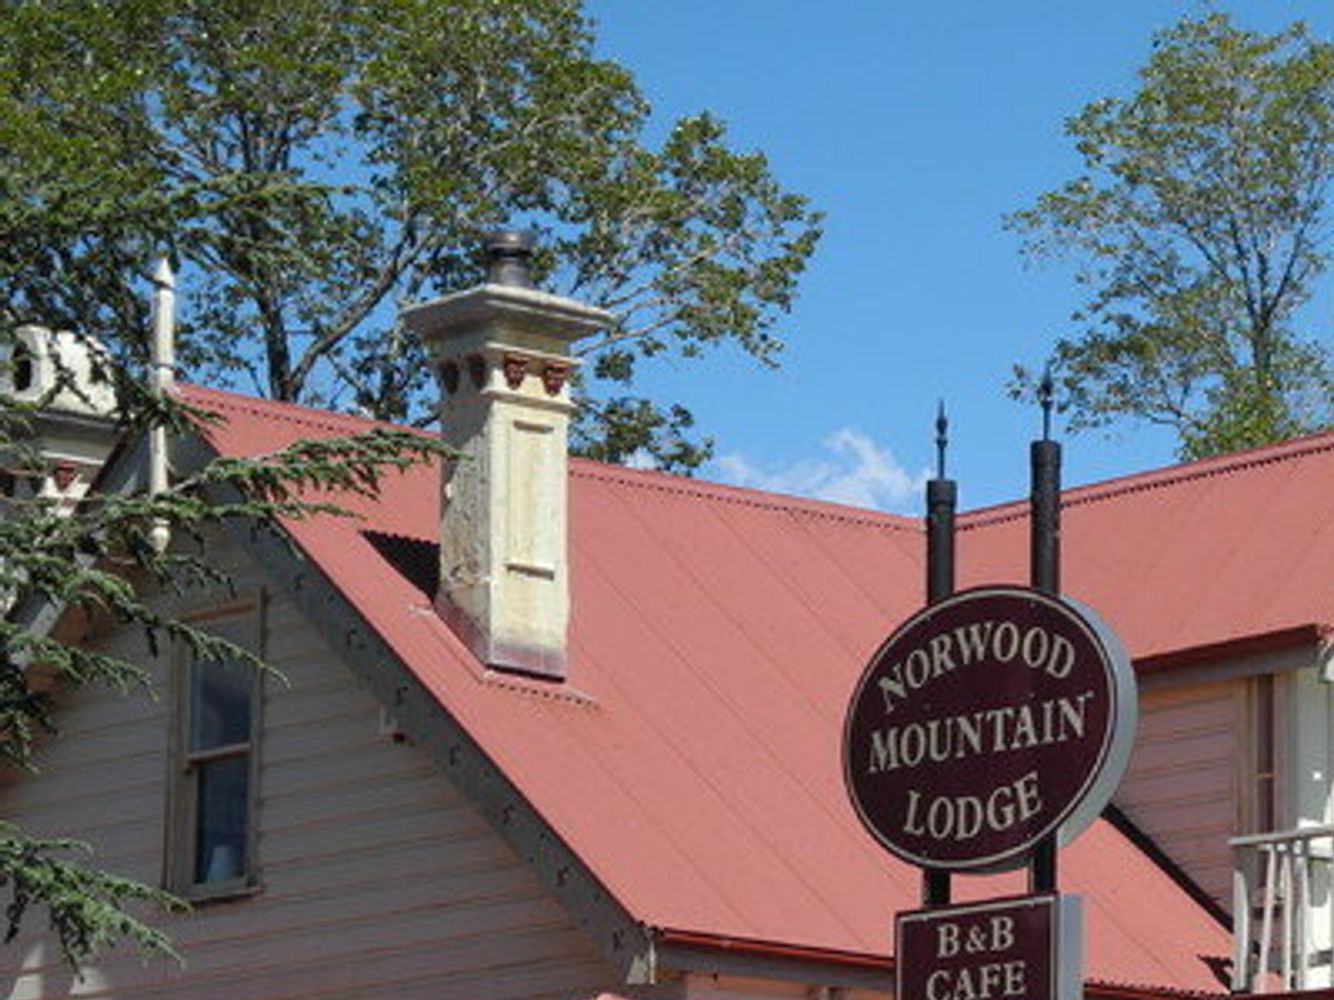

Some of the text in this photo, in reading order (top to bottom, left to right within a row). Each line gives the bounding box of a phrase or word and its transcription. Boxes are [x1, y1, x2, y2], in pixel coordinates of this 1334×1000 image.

[878, 620, 1076, 715] NORWOOD
[867, 690, 1095, 774] MOUNTAIN
[902, 770, 1043, 841] LODGE
[936, 915, 1016, 959] B&B
